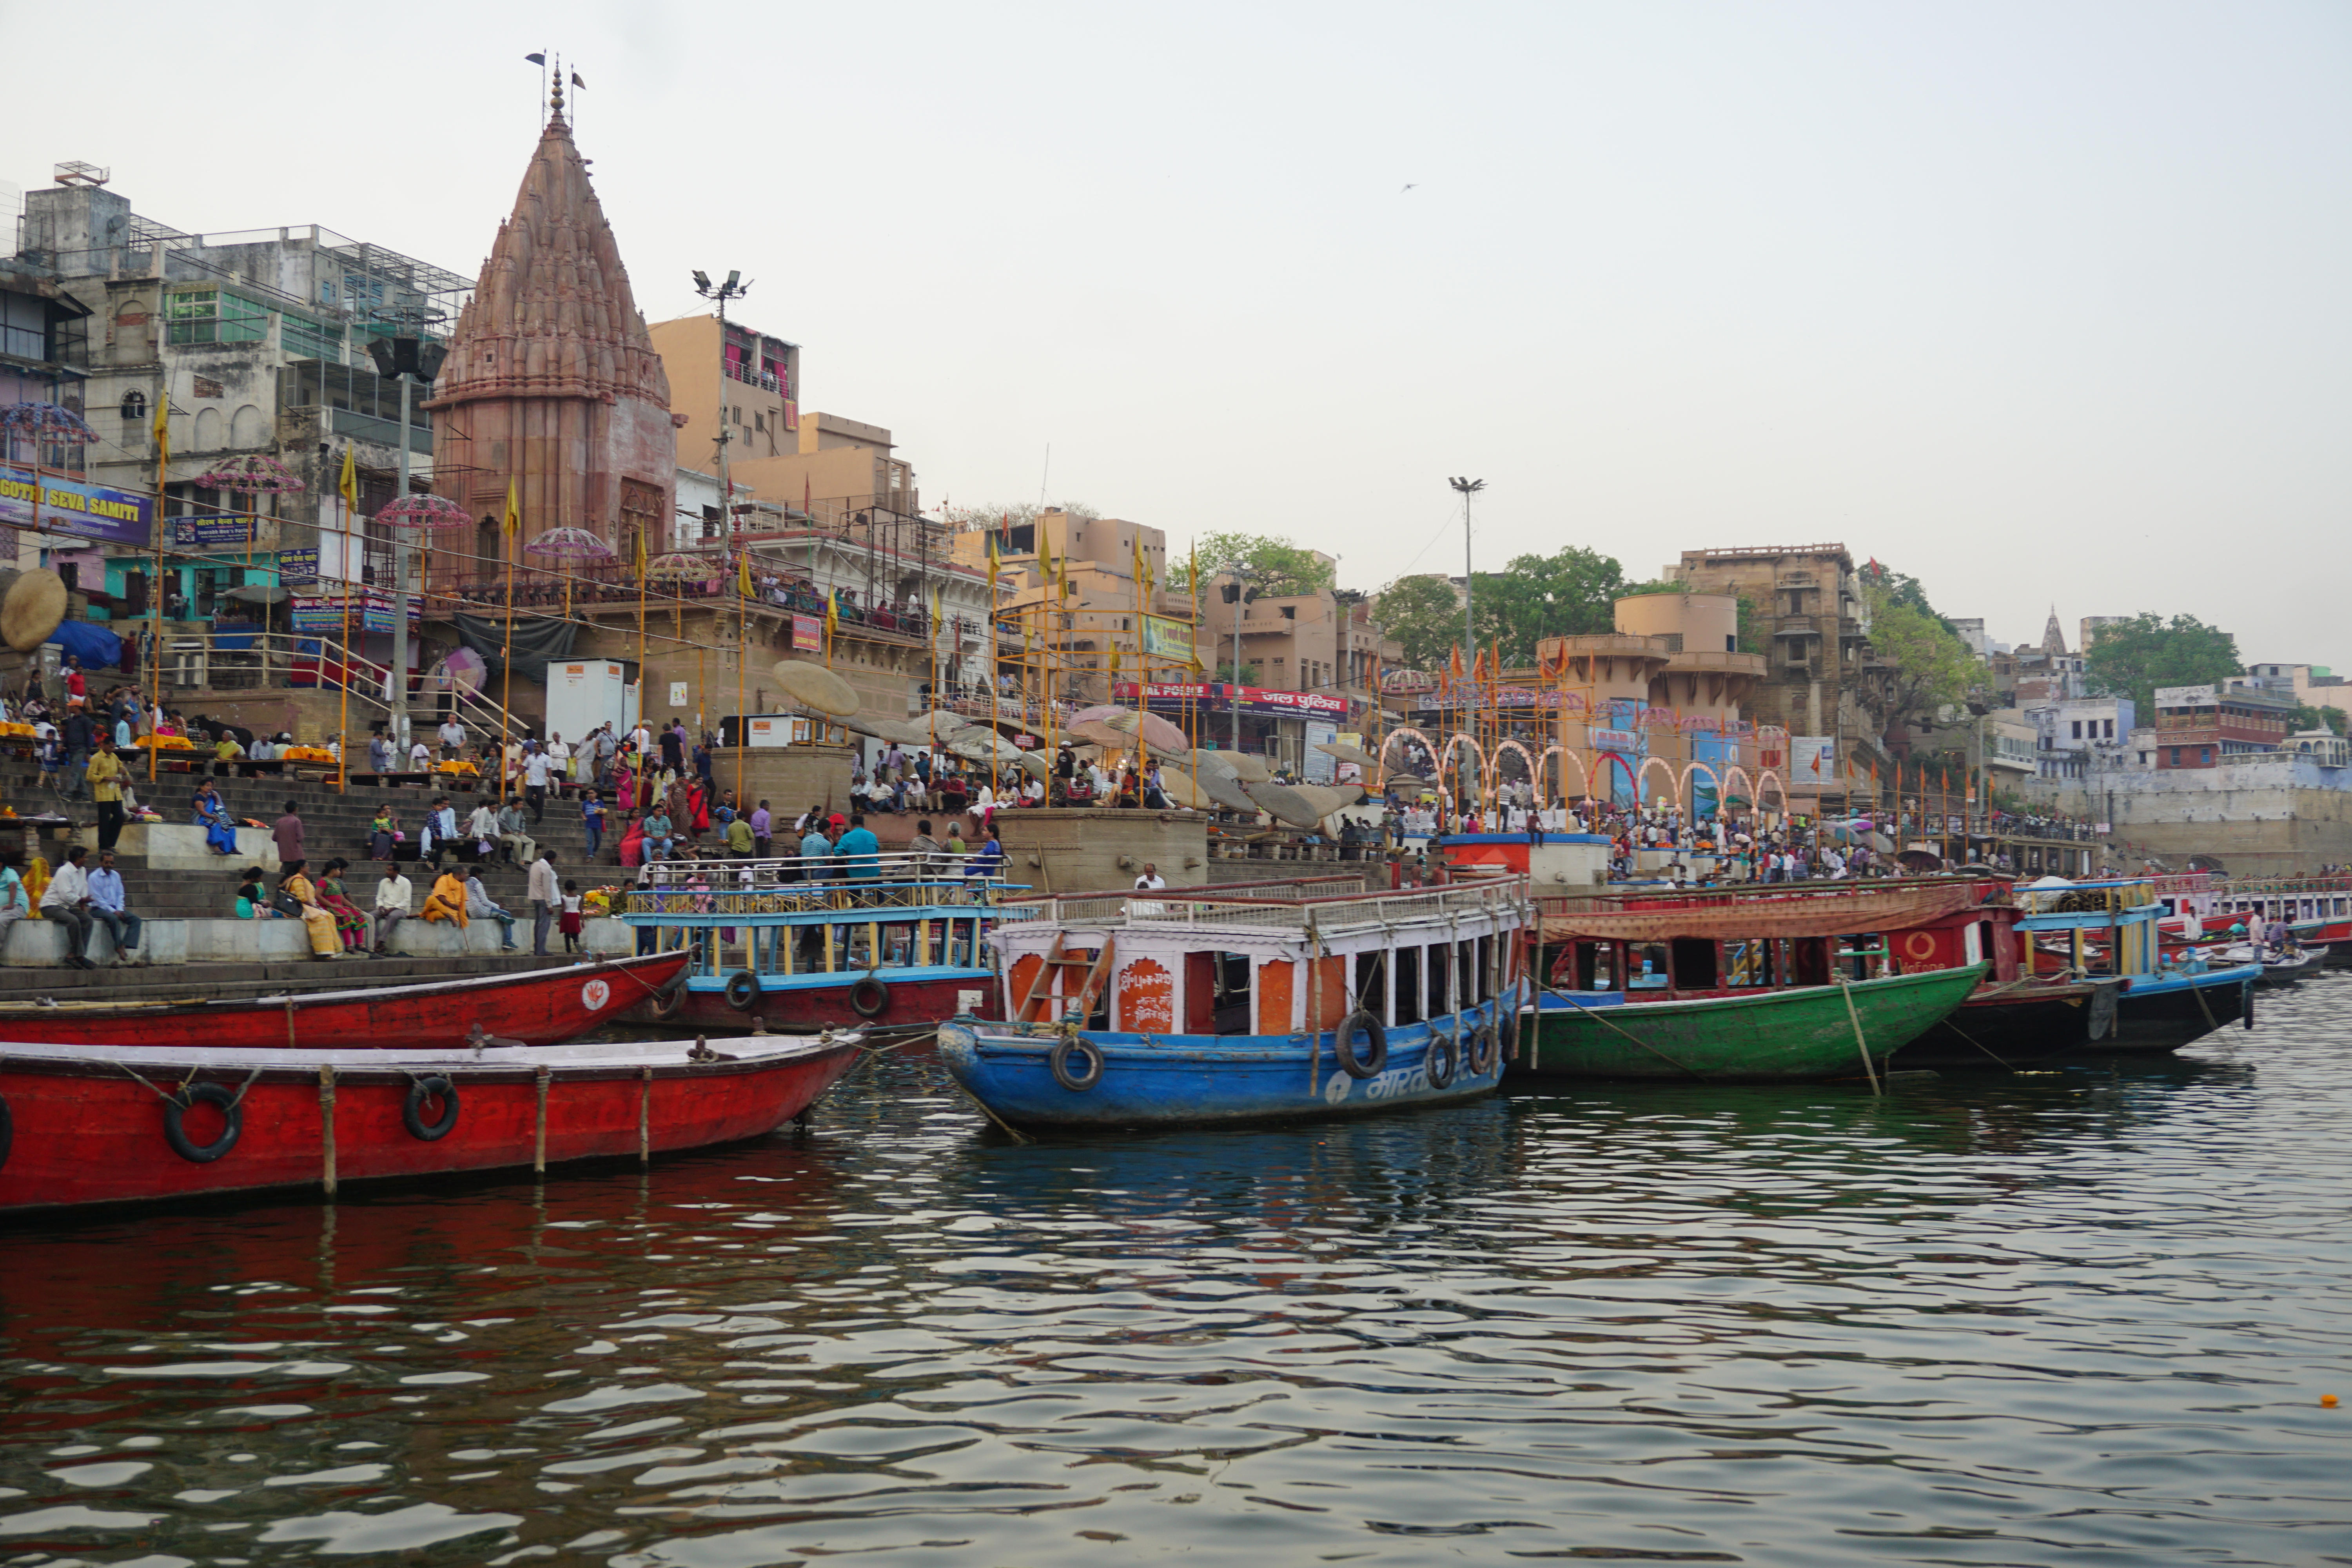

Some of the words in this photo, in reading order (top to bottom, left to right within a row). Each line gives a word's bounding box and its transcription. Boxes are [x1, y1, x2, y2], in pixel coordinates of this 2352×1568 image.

[49, 489, 86, 513] SEVA
[90, 497, 139, 522] SAMITI
[1163, 686, 1203, 696] POLICE
[1261, 692, 1296, 704] जल
[1297, 694, 1342, 710] पुलिस
